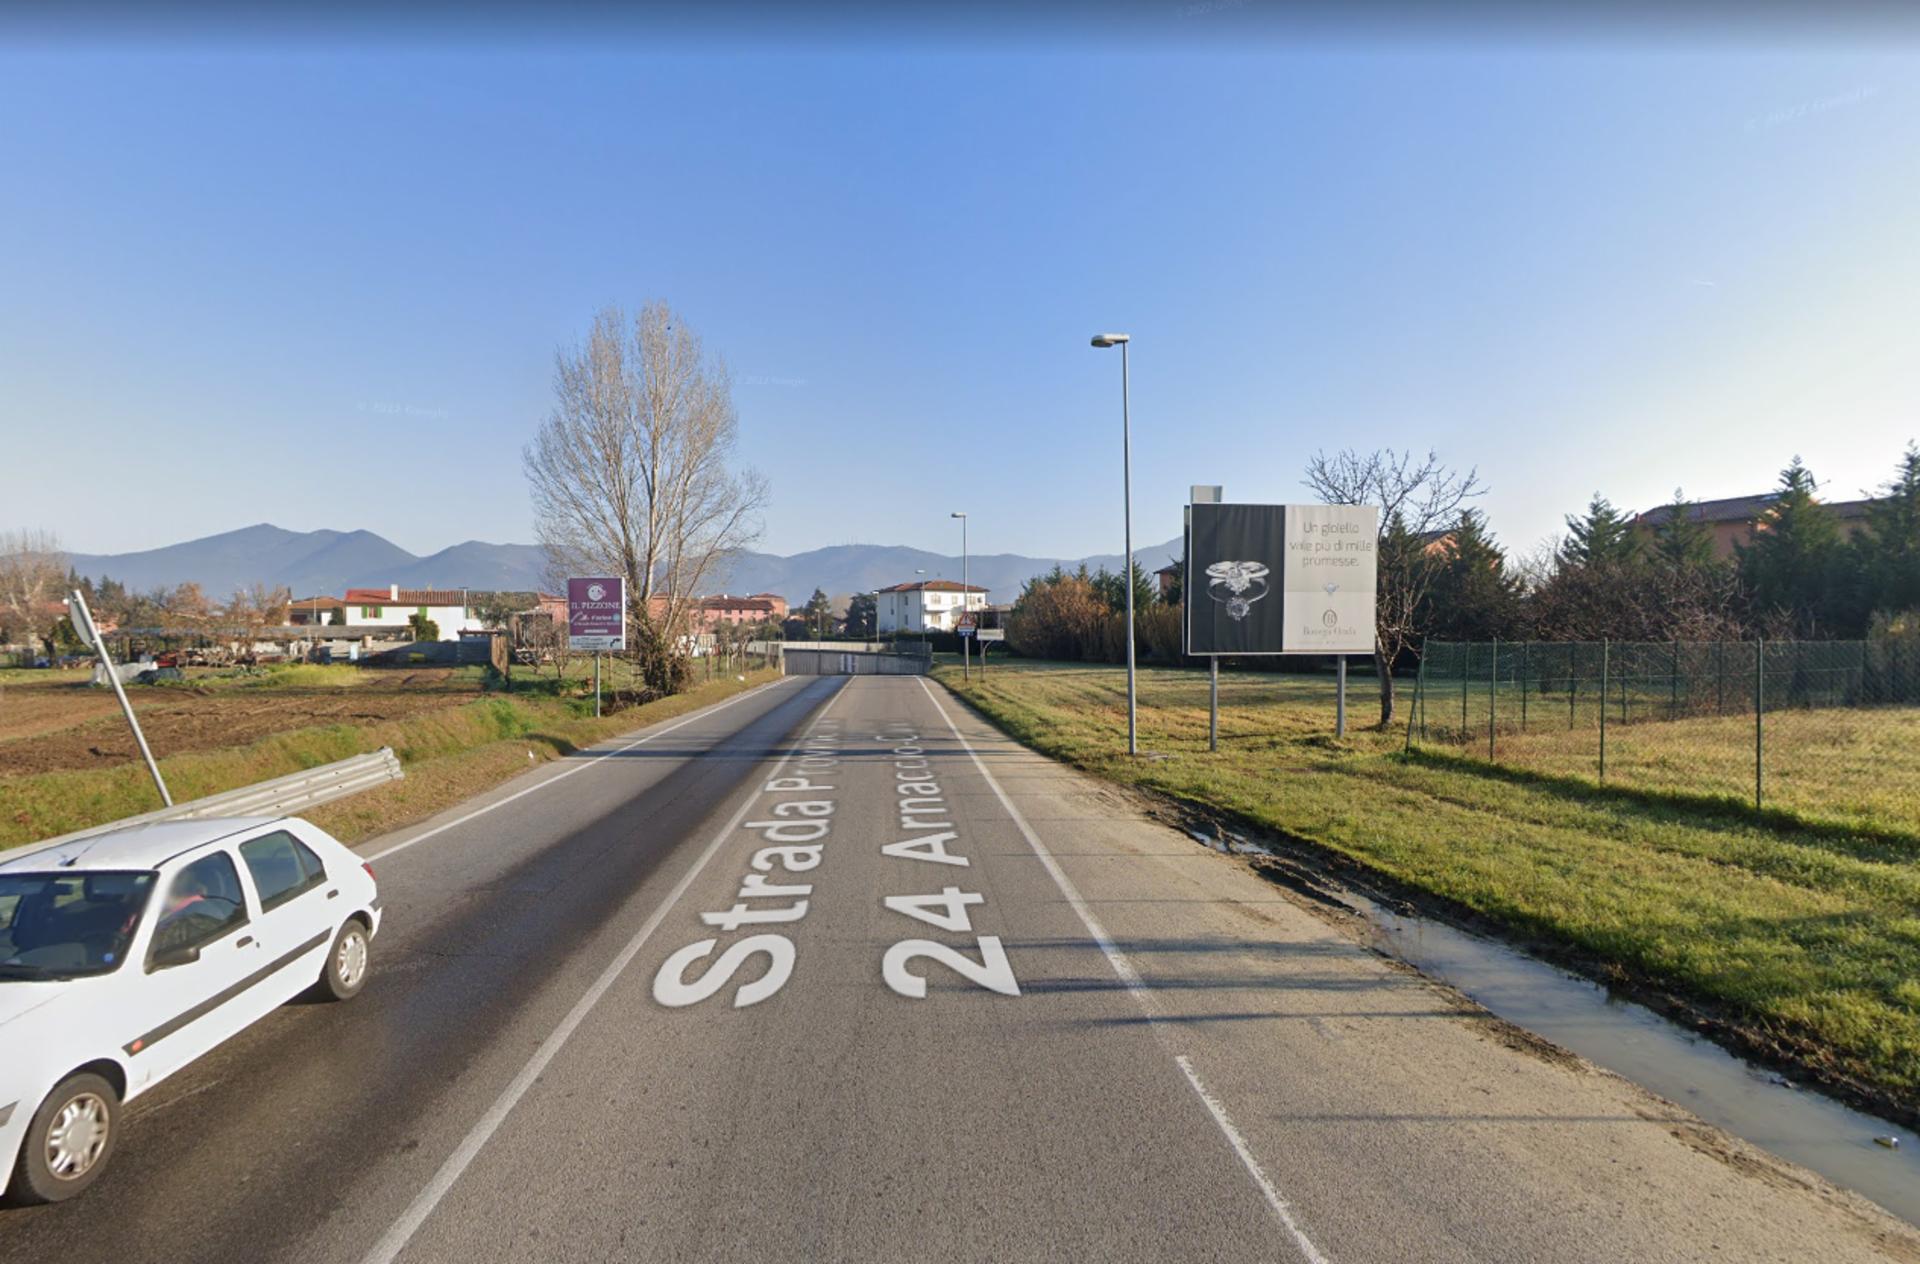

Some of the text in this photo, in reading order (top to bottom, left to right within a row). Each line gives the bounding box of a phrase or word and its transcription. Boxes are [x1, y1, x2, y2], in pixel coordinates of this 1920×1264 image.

[1303, 521, 1360, 537] Un gioiello
[1345, 539, 1373, 552] mille
